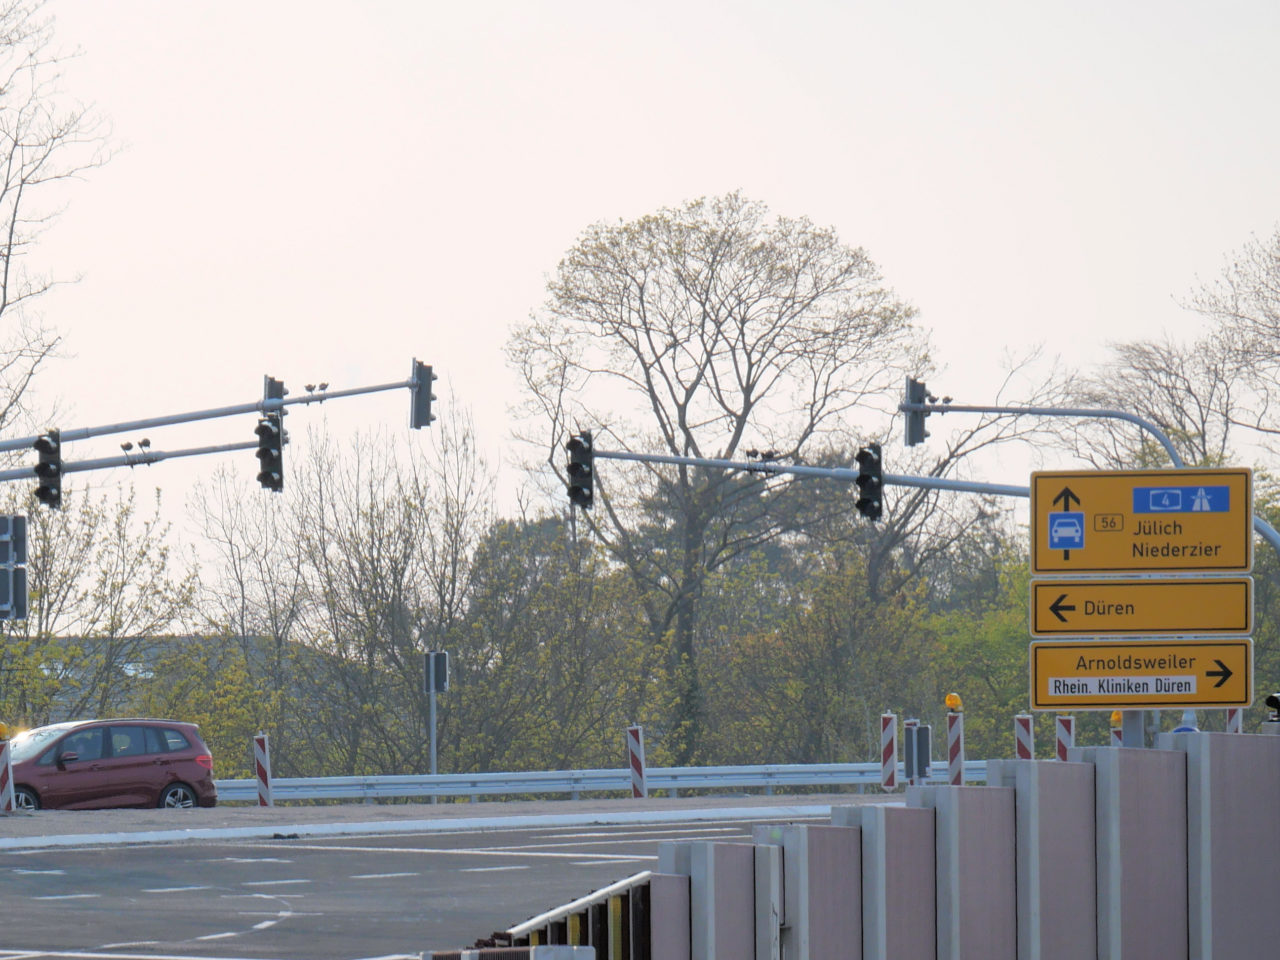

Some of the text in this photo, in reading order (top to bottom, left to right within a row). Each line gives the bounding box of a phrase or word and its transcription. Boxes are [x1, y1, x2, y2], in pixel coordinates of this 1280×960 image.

[1161, 493, 1170, 506] 4
[1100, 516, 1117, 529] 56
[1133, 520, 1183, 536] Jülich
[1132, 543, 1222, 557] Niederzier
[1084, 600, 1135, 615] Düren
[1076, 655, 1196, 670] Arnoldsweiler
[1053, 677, 1192, 694] Rhein. Kliniken Düren
